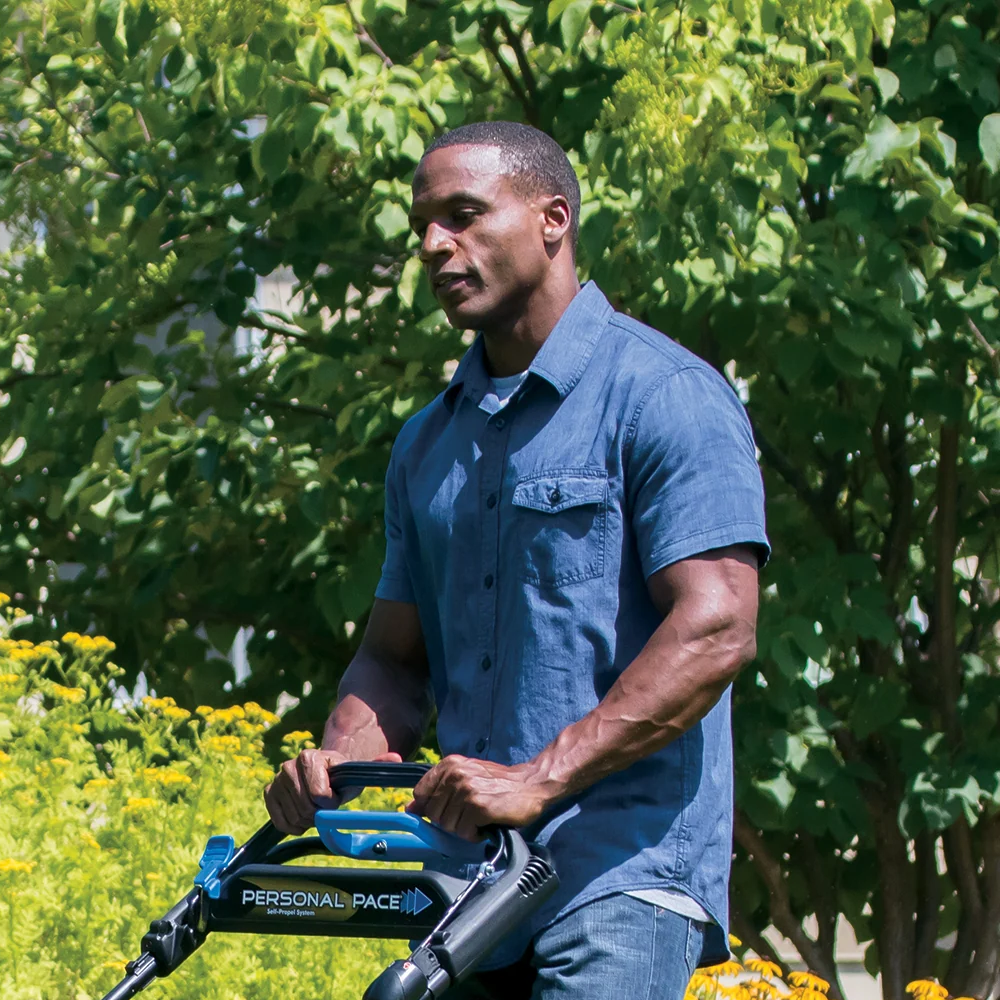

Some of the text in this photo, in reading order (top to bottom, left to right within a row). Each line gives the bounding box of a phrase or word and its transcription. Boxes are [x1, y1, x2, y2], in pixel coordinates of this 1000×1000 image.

[242, 890, 399, 909] PERSONAL PACE
[267, 908, 296, 916] Self-Propel
